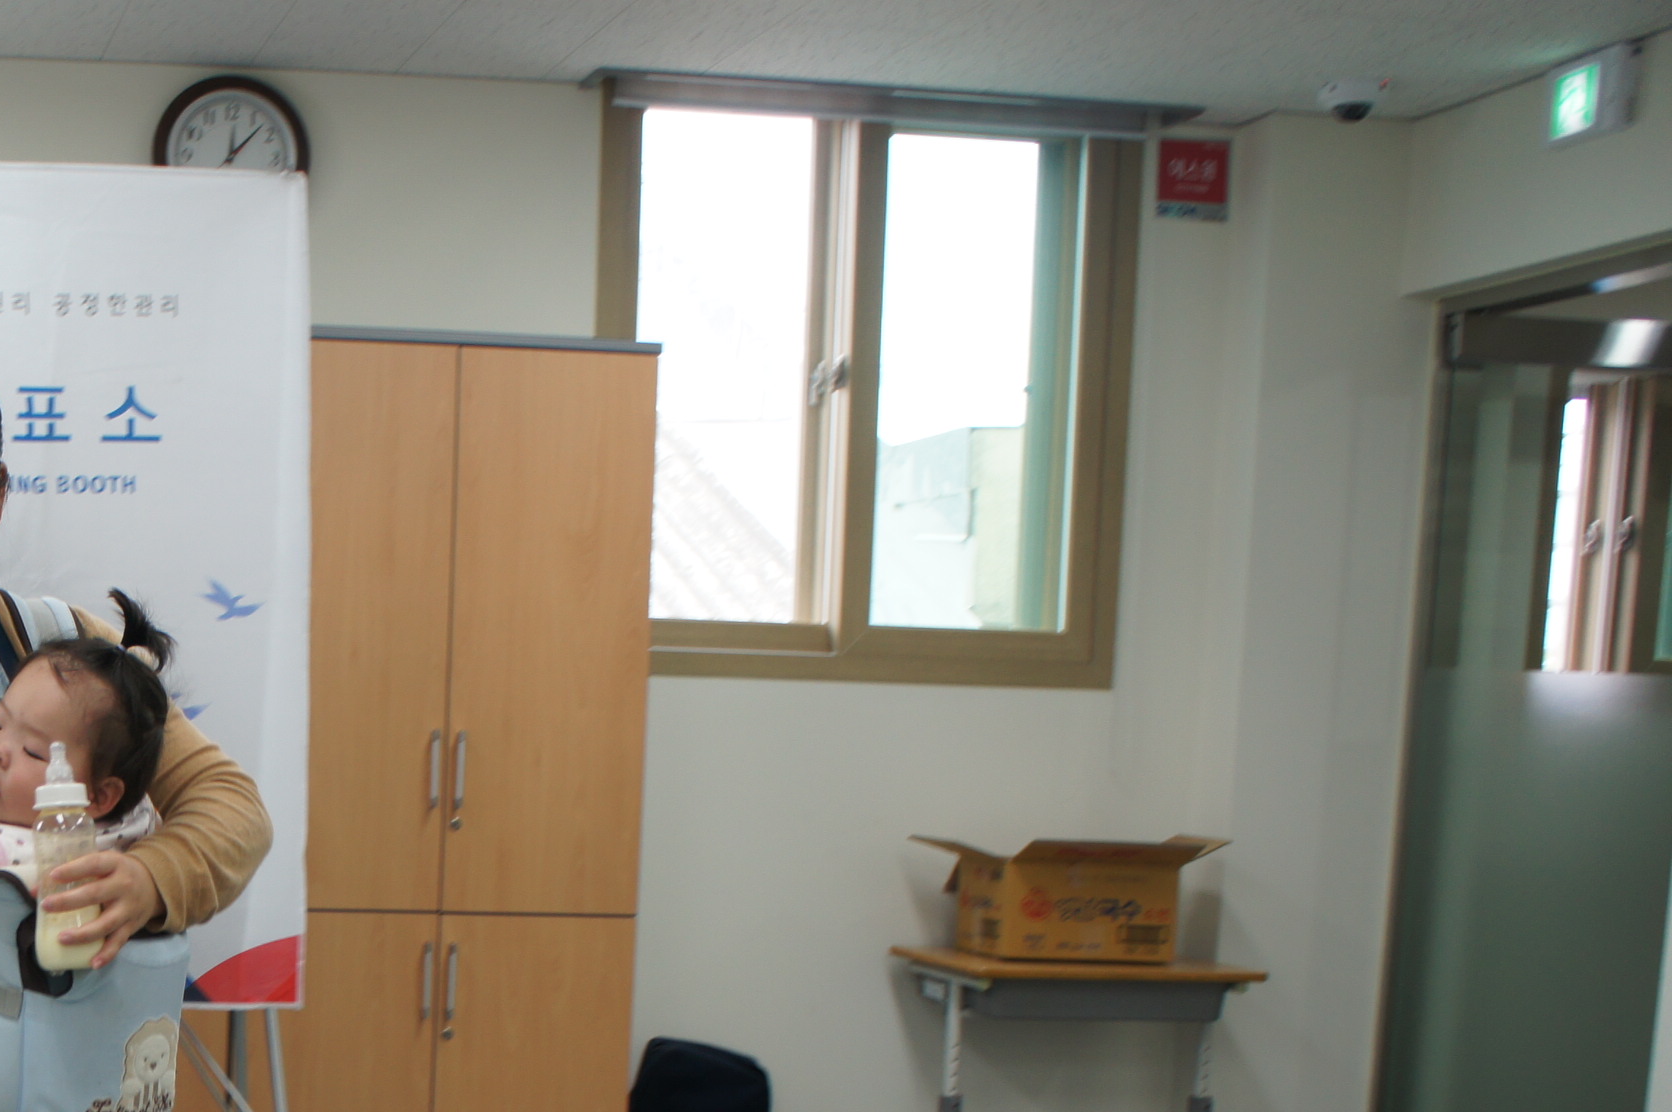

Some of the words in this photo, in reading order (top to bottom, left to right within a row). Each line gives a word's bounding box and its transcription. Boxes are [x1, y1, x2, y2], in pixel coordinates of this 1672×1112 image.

[202, 109, 217, 126] 11
[224, 102, 241, 121] 12
[249, 110, 260, 127] 1
[264, 127, 277, 144] 2
[52, 292, 179, 318] 공정한관리
[11, 385, 163, 444] 표소
[55, 474, 137, 495] BOOTH
